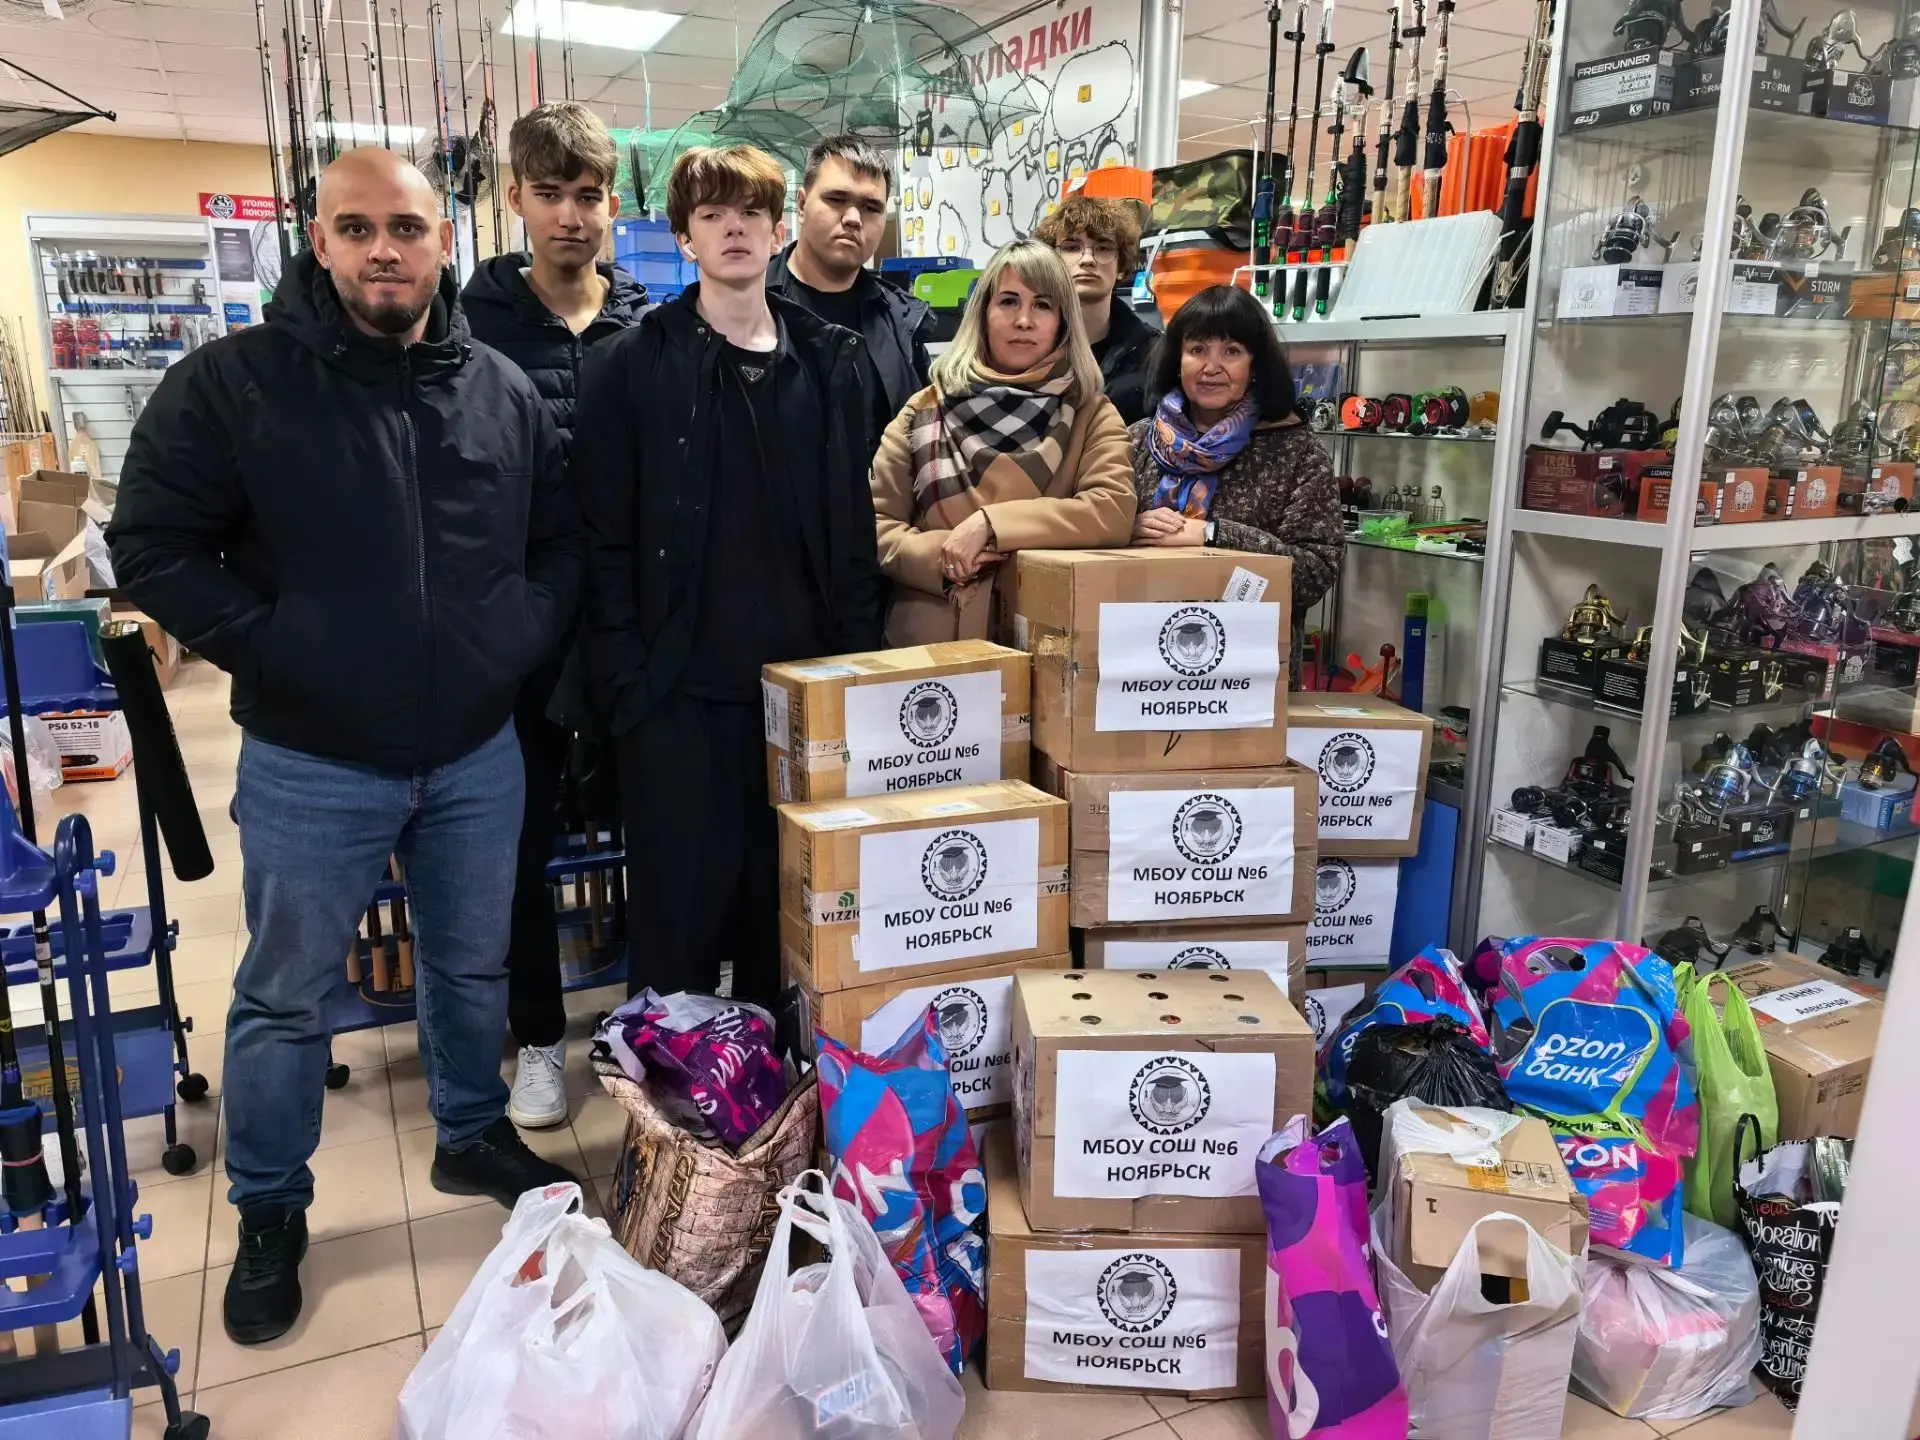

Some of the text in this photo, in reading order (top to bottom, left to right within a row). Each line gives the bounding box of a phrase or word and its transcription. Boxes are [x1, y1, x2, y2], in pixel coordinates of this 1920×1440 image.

[1577, 54, 1651, 77] FREERUNNER
[1760, 81, 1791, 94] STORM
[241, 199, 275, 209] УГОЛОК
[1811, 280, 1841, 293] STORM
[1121, 677, 1251, 693] МБОУ СОШ №6
[1141, 700, 1228, 716] НОЯБРЬСК
[48, 721, 99, 731] PSG 52-18
[868, 743, 980, 773] МБОУ СОШ №6
[886, 768, 963, 792] НОЯБРЬСК
[1331, 795, 1365, 808] СОШ
[1368, 795, 1393, 808] №6
[1318, 815, 1373, 828] ЯБРЬСК
[1133, 865, 1268, 881] МБОУ СОШ №6
[1154, 889, 1245, 905] НОЯБРЬСК
[821, 910, 860, 923] VIZZI
[884, 897, 1013, 929] МБОУ СОШ №6
[1313, 914, 1373, 928] СОШ №6
[905, 924, 993, 950] НОЯБРЬСК
[1305, 933, 1354, 948] ЯБРЬСК
[1535, 1033, 1627, 1061] ozon
[951, 1058, 981, 1074] ОШ
[1525, 1055, 1607, 1088] банк
[952, 1076, 993, 1095] РЬСК
[1083, 1138, 1238, 1155] МБОУ СОШ №6
[1557, 1142, 1638, 1171] ZON
[1107, 1163, 1211, 1182] НОЯБРЬСК
[1053, 1331, 1207, 1350] МБОУ СОШ №6
[1077, 1354, 1181, 1374] НОЯБРЬСК
